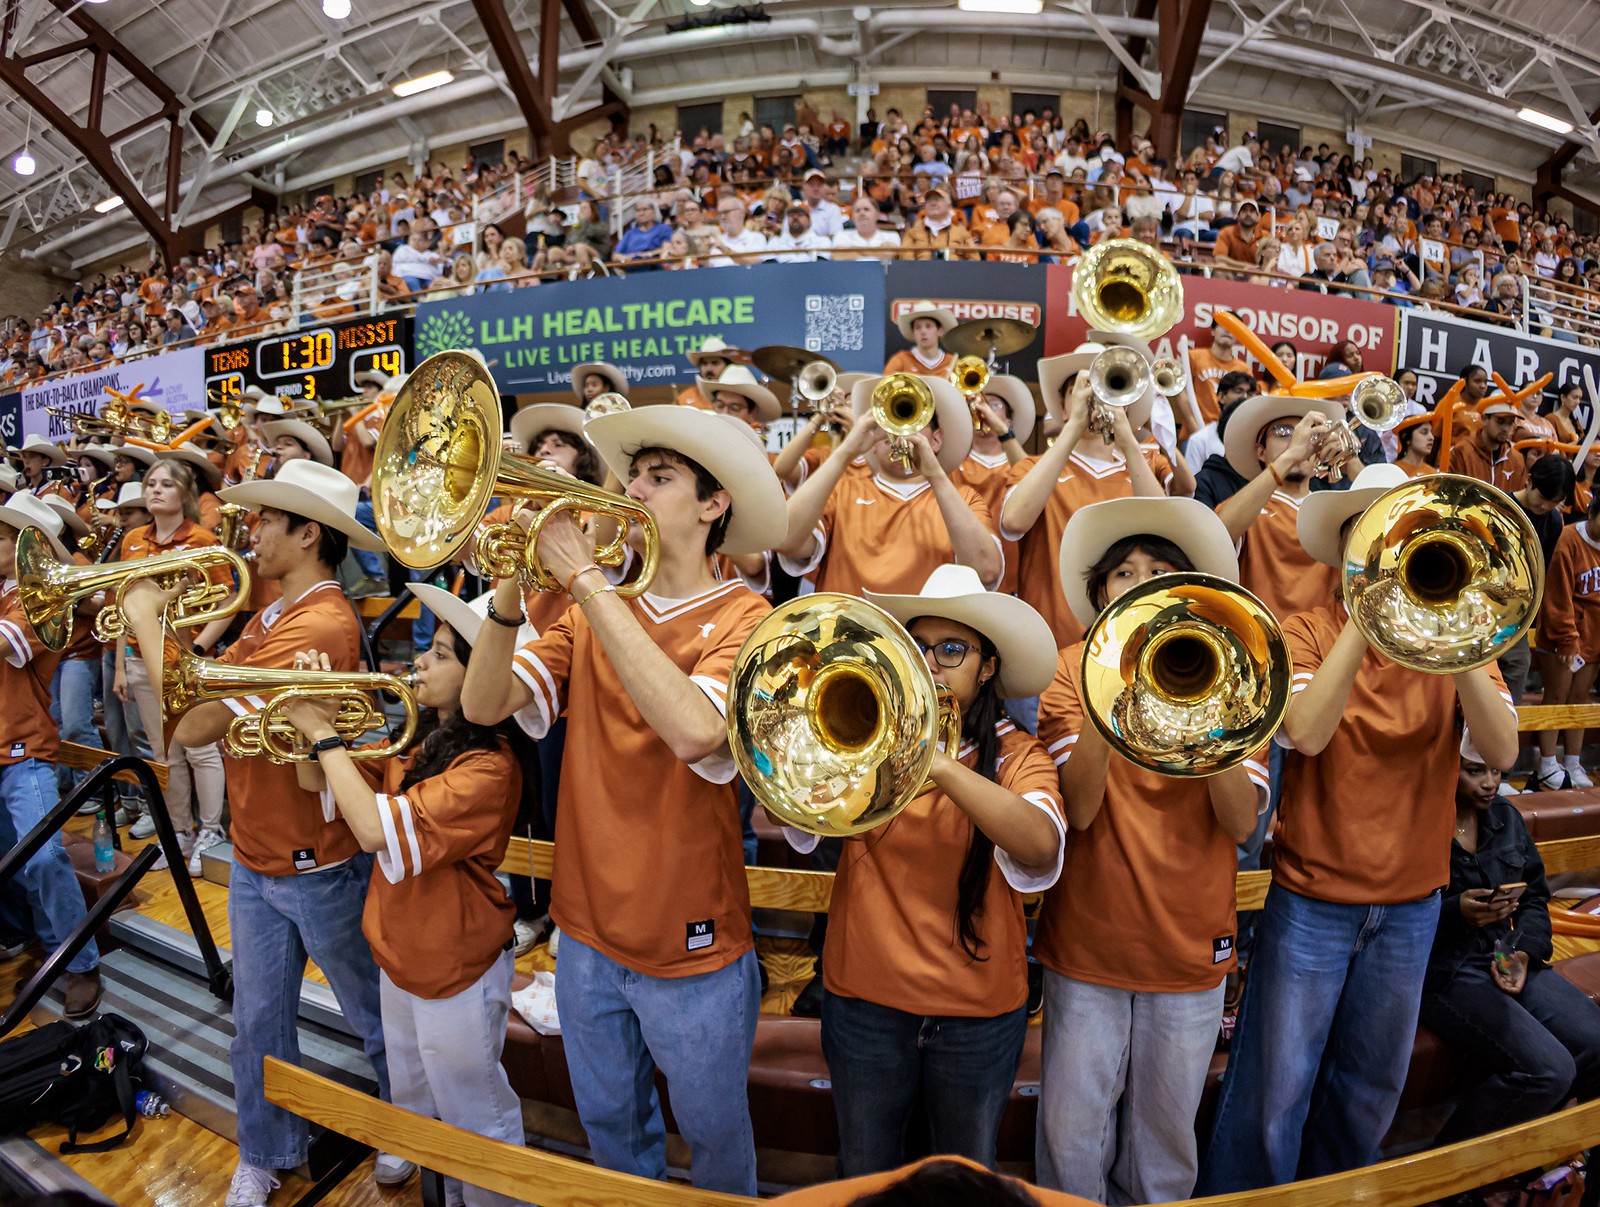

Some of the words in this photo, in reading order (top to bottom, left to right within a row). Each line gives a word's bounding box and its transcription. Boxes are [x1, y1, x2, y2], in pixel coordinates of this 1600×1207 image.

[480, 314, 534, 345] LLH
[543, 296, 755, 338] HEALTHCARE
[898, 302, 1035, 325] FHOUSE
[338, 320, 398, 349] MISSST
[1347, 323, 1384, 351] OF
[211, 349, 250, 373] TEXAS
[282, 332, 333, 370] 1:30
[504, 347, 551, 369] LIVE
[558, 340, 605, 363] LIFE
[1419, 326, 1600, 390] HARG
[372, 351, 400, 377] 14
[547, 364, 676, 384] Livethy.com
[275, 383, 303, 398] PERIOD
[304, 374, 317, 400] 3
[25, 393, 35, 412] THE
[299, 851, 307, 859] S
[695, 923, 706, 934] M
[1220, 939, 1229, 948] M
